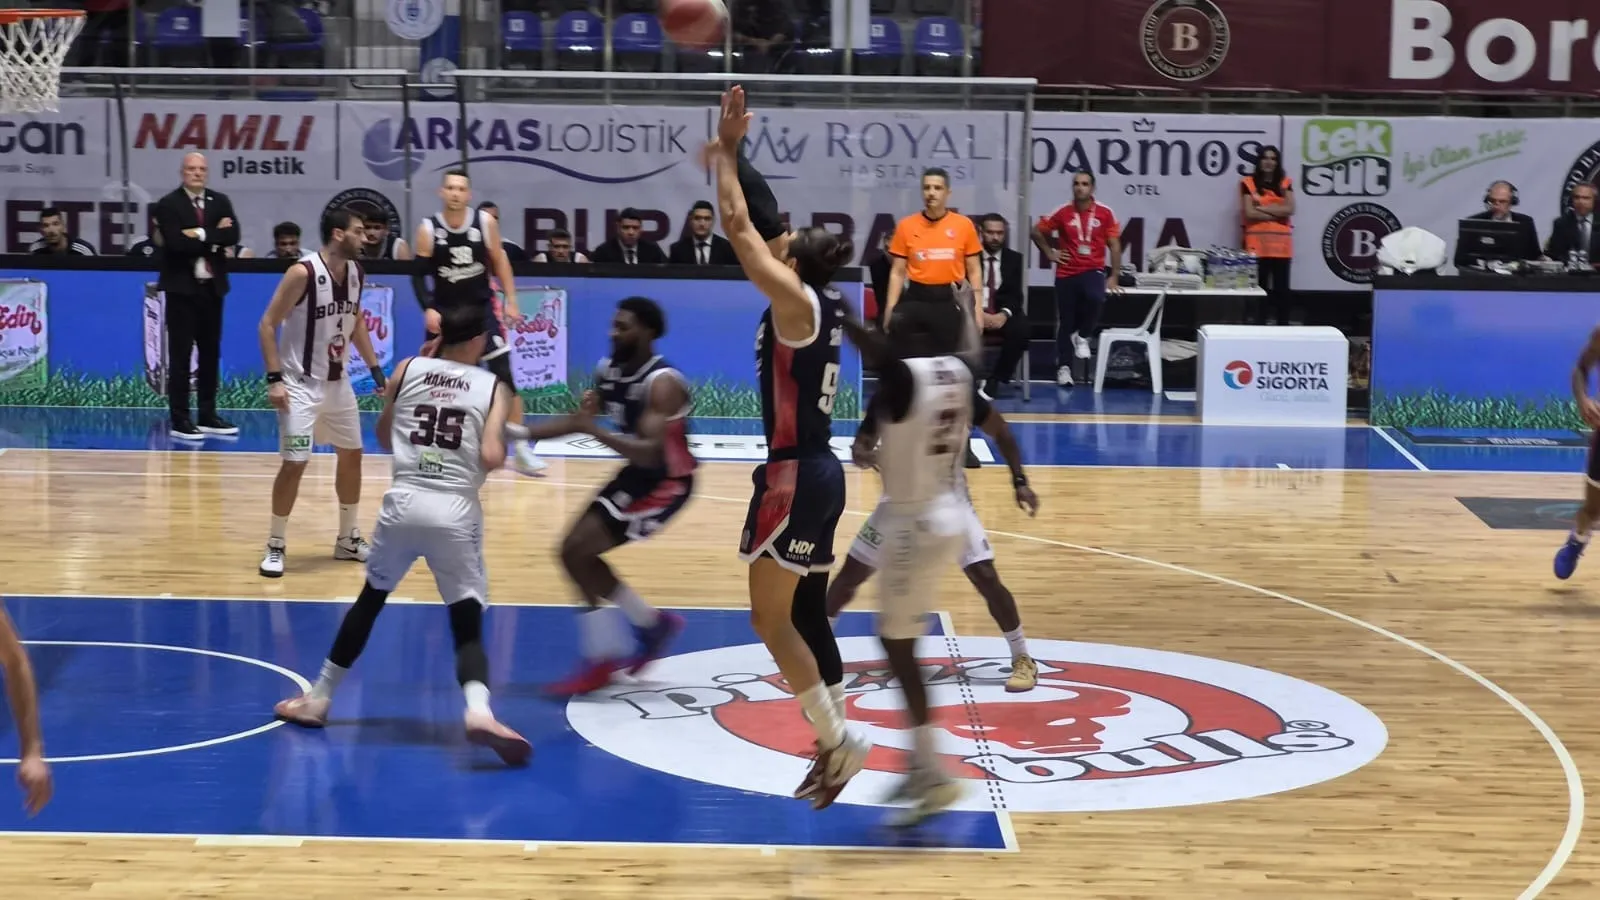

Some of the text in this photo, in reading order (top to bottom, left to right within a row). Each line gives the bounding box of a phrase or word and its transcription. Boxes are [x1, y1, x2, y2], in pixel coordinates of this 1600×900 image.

[1170, 22, 1199, 51] B
[1389, 0, 1600, 82] Bor
[133, 113, 315, 151] NAMLI
[825, 122, 992, 160] ROYAL
[222, 157, 305, 178] plastik
[1124, 184, 1160, 196] OTEL
[1349, 229, 1377, 257] B
[410, 404, 467, 450] 35
[788, 538, 816, 555] HDI
